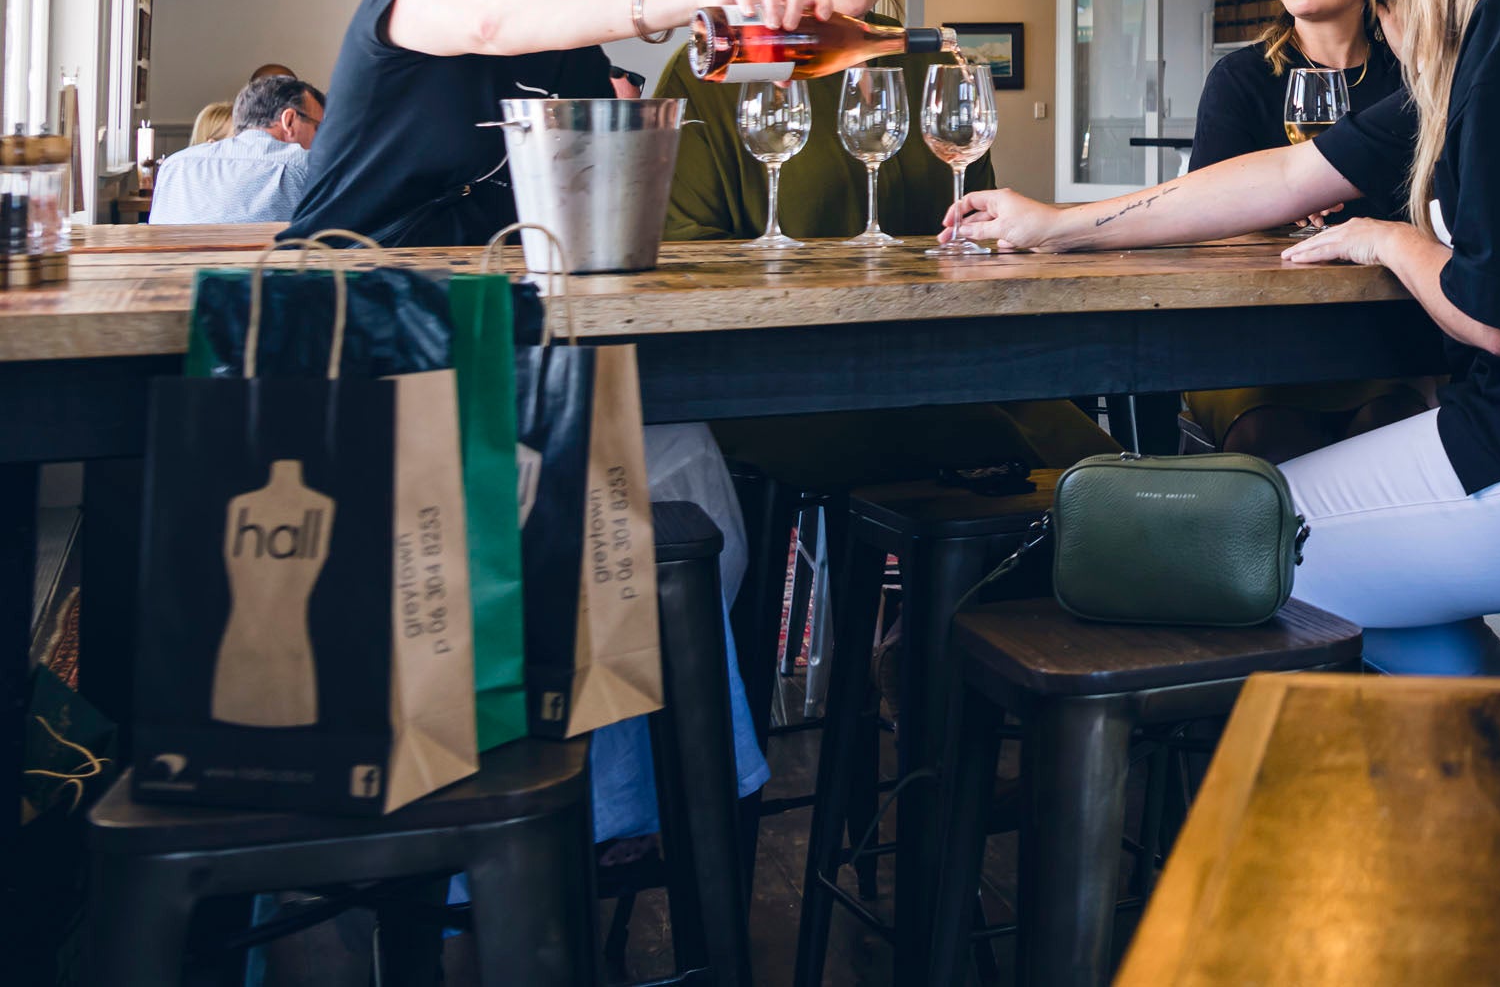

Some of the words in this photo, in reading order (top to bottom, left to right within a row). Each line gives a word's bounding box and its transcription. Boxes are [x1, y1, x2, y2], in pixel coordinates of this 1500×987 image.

[607, 465, 629, 510] 8253
[233, 507, 324, 560] hall
[418, 505, 442, 557] 8253
[588, 488, 612, 584] greytown
[612, 517, 631, 551] 304
[397, 532, 424, 639] greytown
[423, 564, 447, 601] 304
[615, 557, 634, 582] 06
[426, 606, 448, 634] 06
